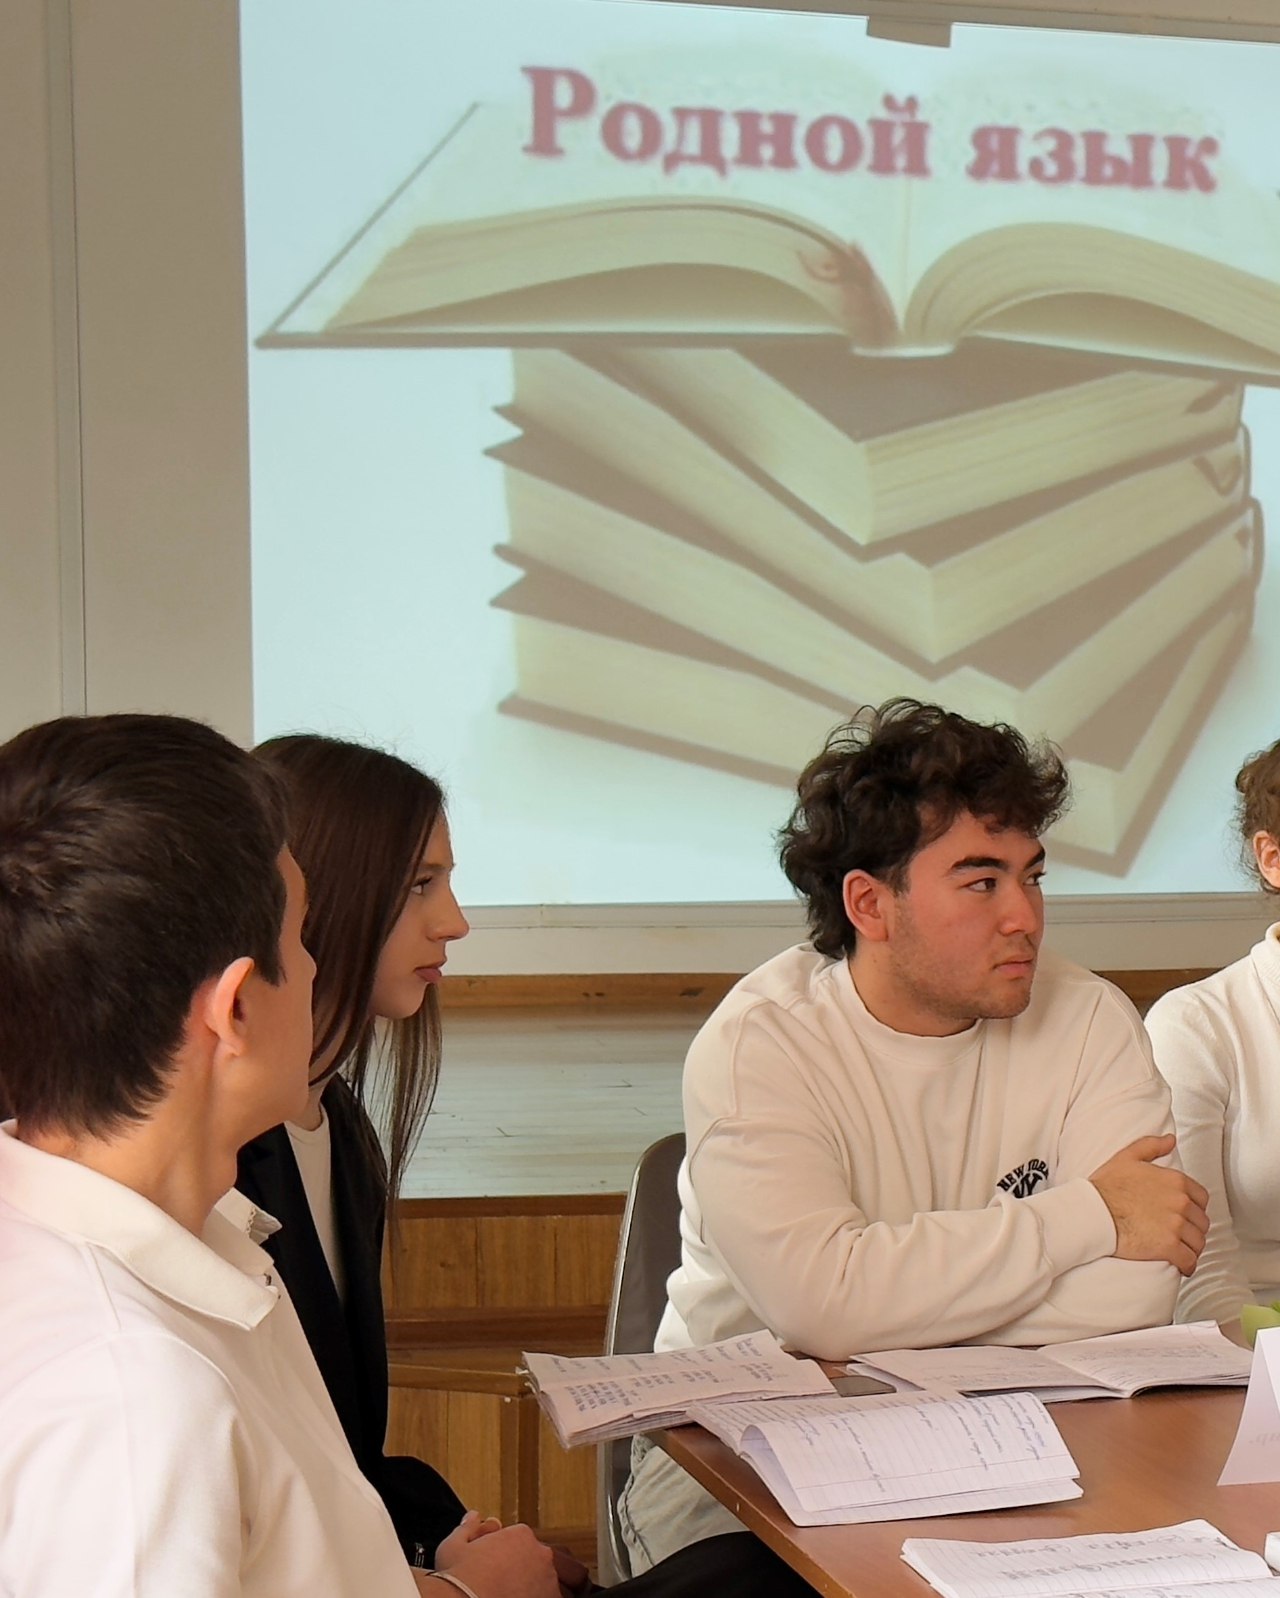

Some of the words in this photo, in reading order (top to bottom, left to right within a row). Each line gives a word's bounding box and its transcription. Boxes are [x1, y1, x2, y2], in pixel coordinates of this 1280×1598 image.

[520, 65, 931, 179] Родной
[966, 125, 1219, 193] язык
[996, 1164, 1024, 1192] NEW
